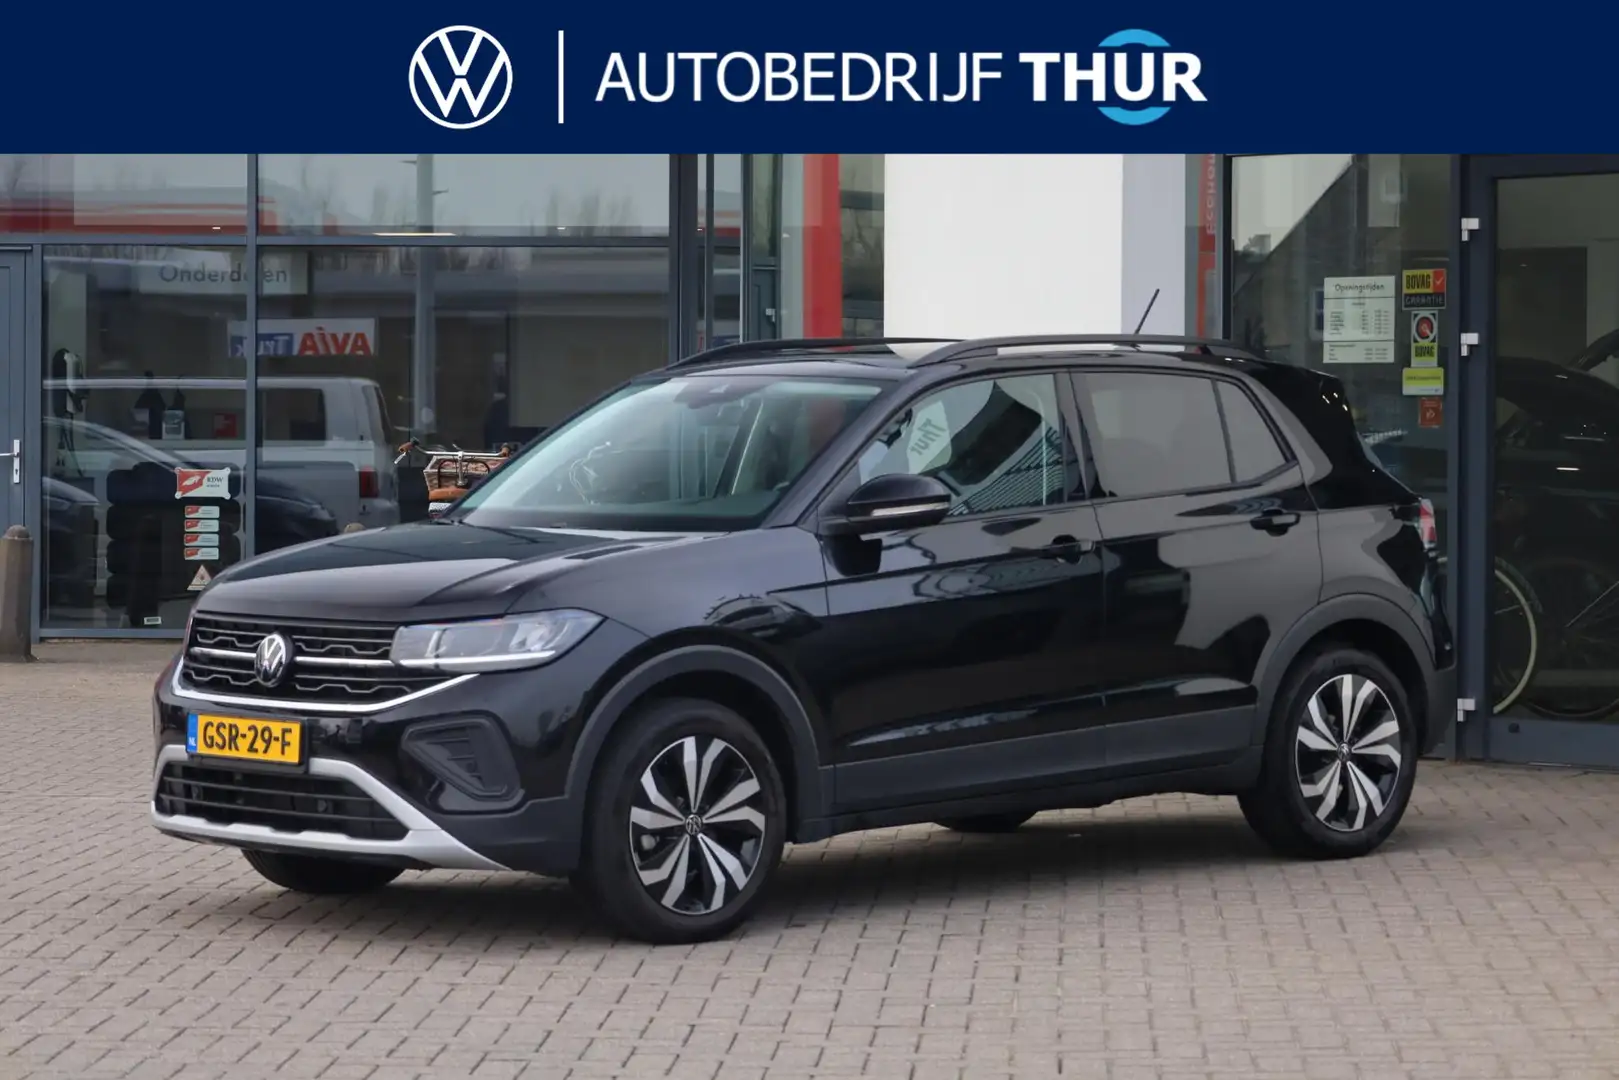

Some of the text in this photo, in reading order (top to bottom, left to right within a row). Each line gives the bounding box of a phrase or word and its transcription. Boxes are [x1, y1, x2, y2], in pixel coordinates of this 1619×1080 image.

[160, 263, 287, 282] Onderden
[1405, 274, 1432, 290] BOVAG
[203, 721, 292, 756] GSR-29-F
